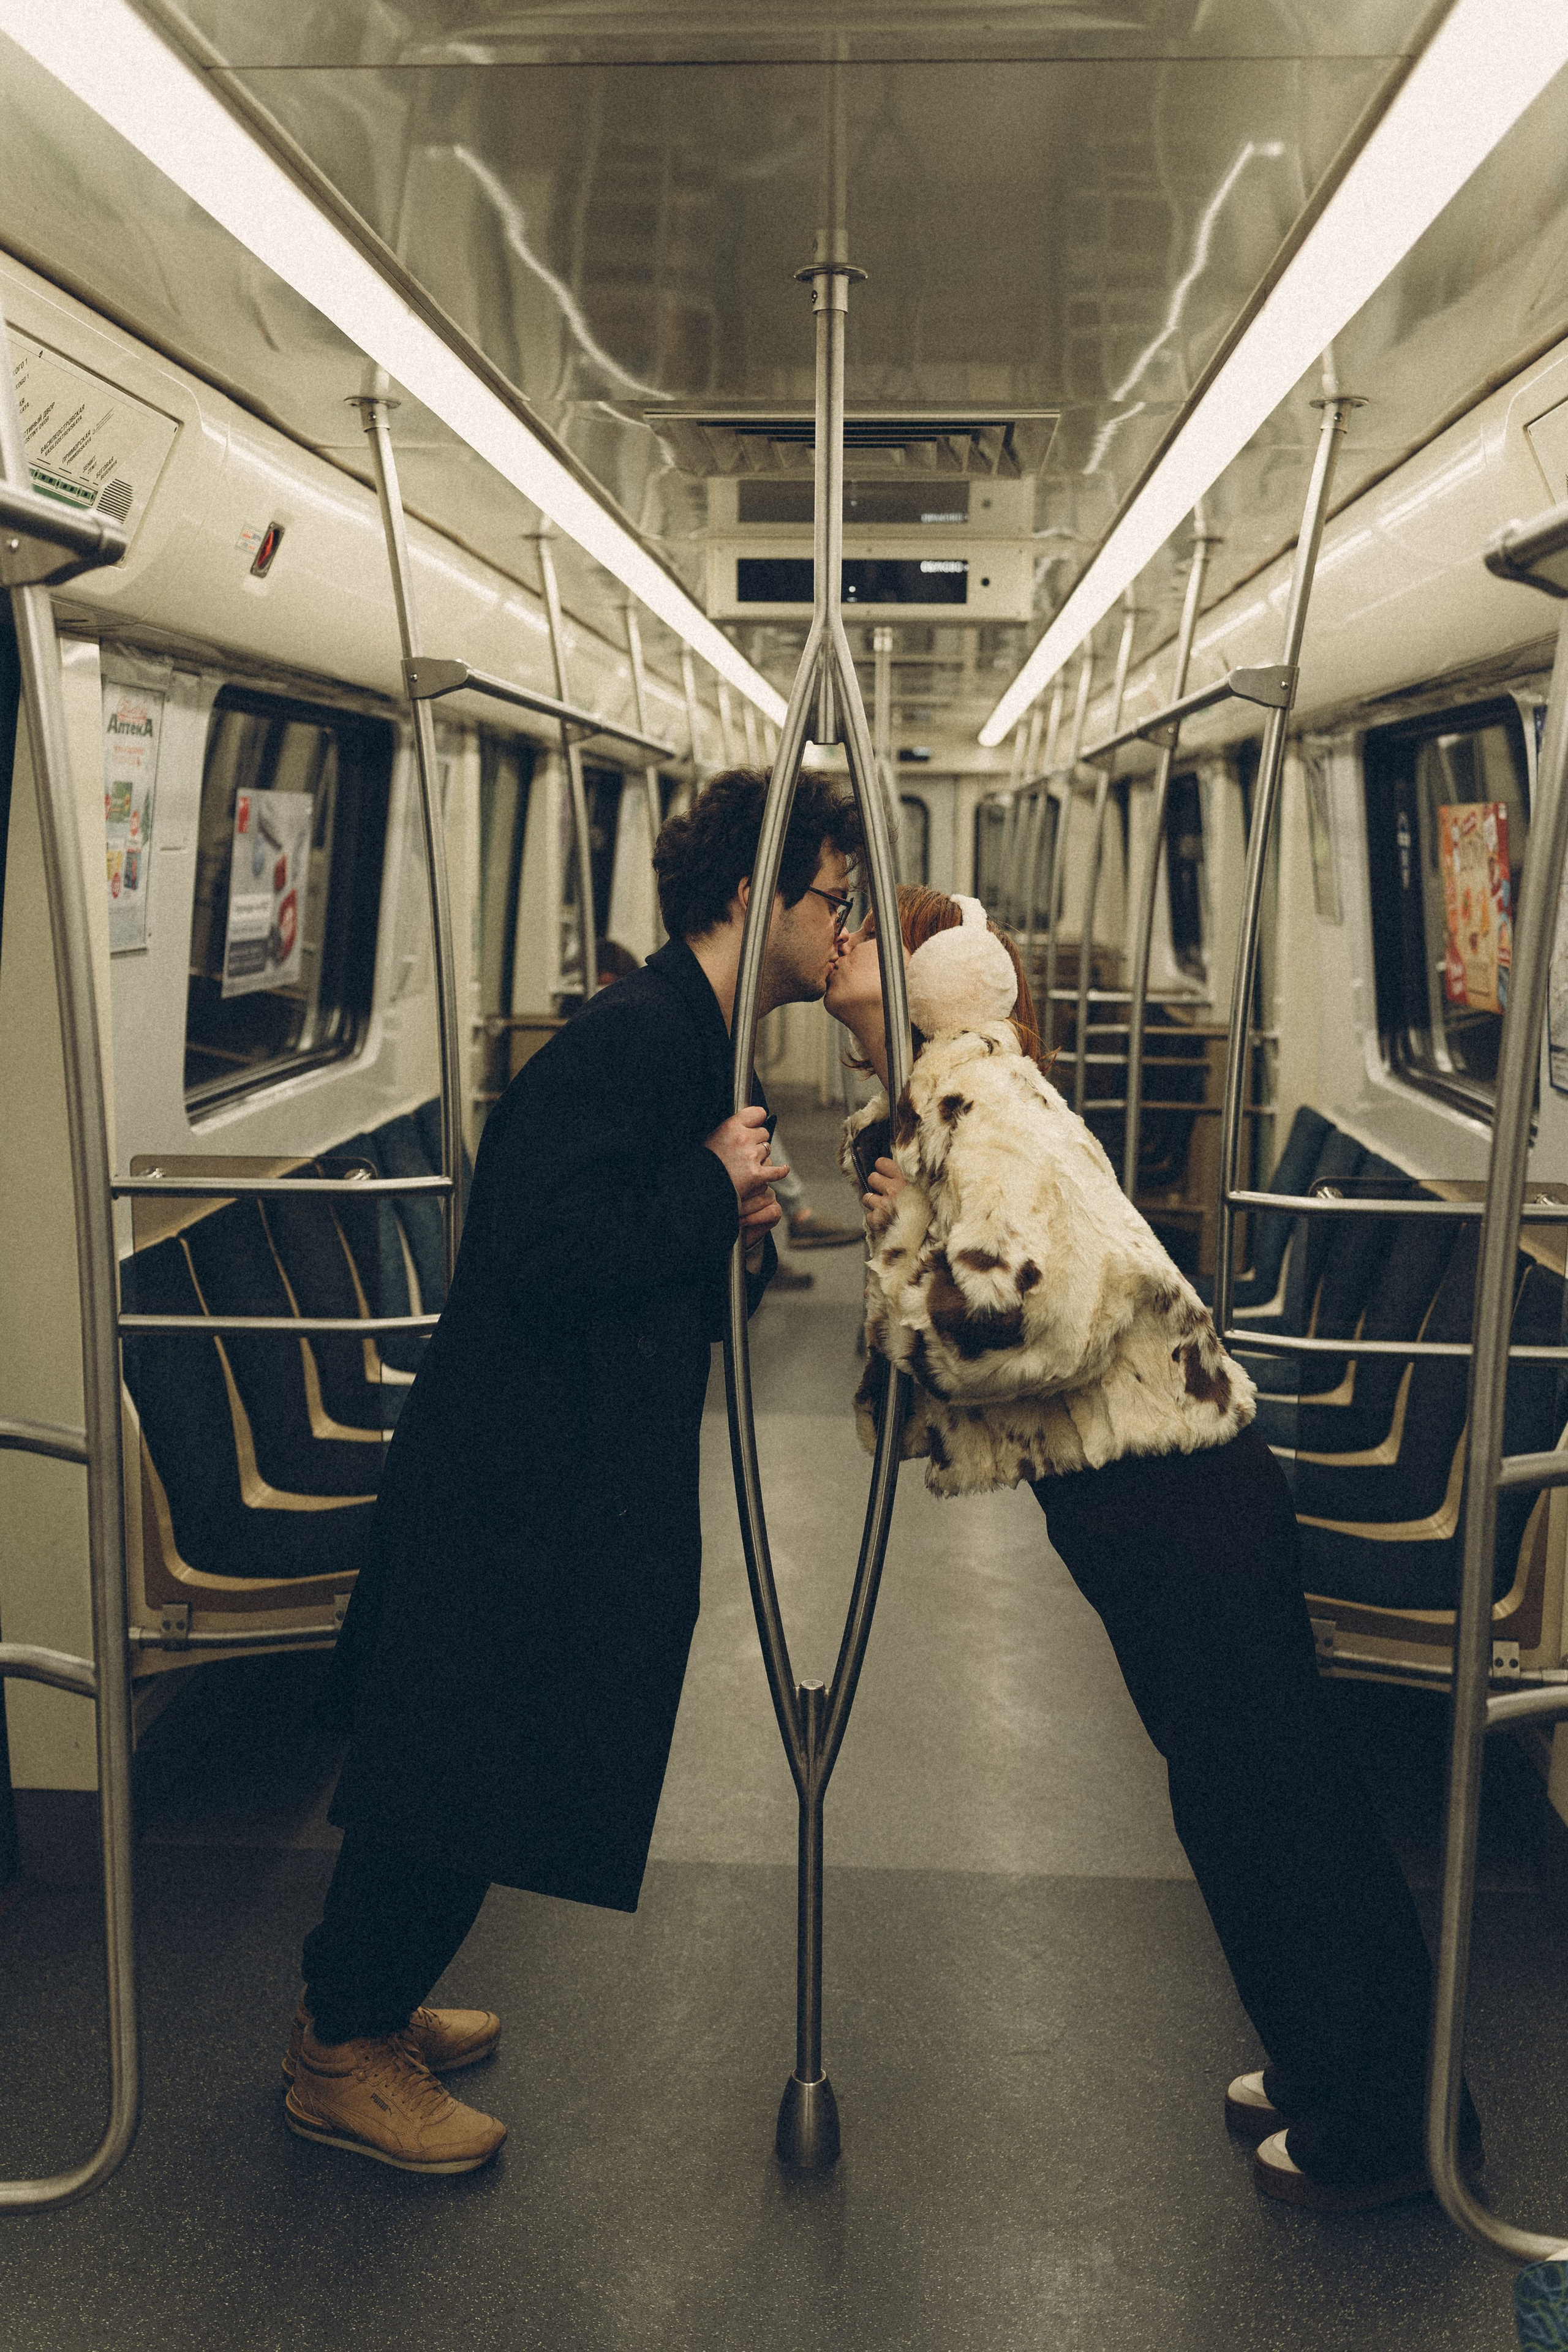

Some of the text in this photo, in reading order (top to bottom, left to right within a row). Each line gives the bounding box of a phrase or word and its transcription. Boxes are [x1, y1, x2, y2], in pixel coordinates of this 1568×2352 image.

[24, 414, 42, 437] СТИНЫЙ
[43, 401, 55, 420] ДВОР
[25, 416, 50, 444] OSTINY DVOR
[40, 404, 85, 454] ВАСИЛЕОСТРОВСКАЯ
[45, 415, 82, 456] VASILEOSTROVSKAYA
[62, 429, 91, 464] ПРИМОРСКАЯ
[67, 436, 92, 466] PRIMORSKAYA
[370, 2092, 389, 2112] PUMA
